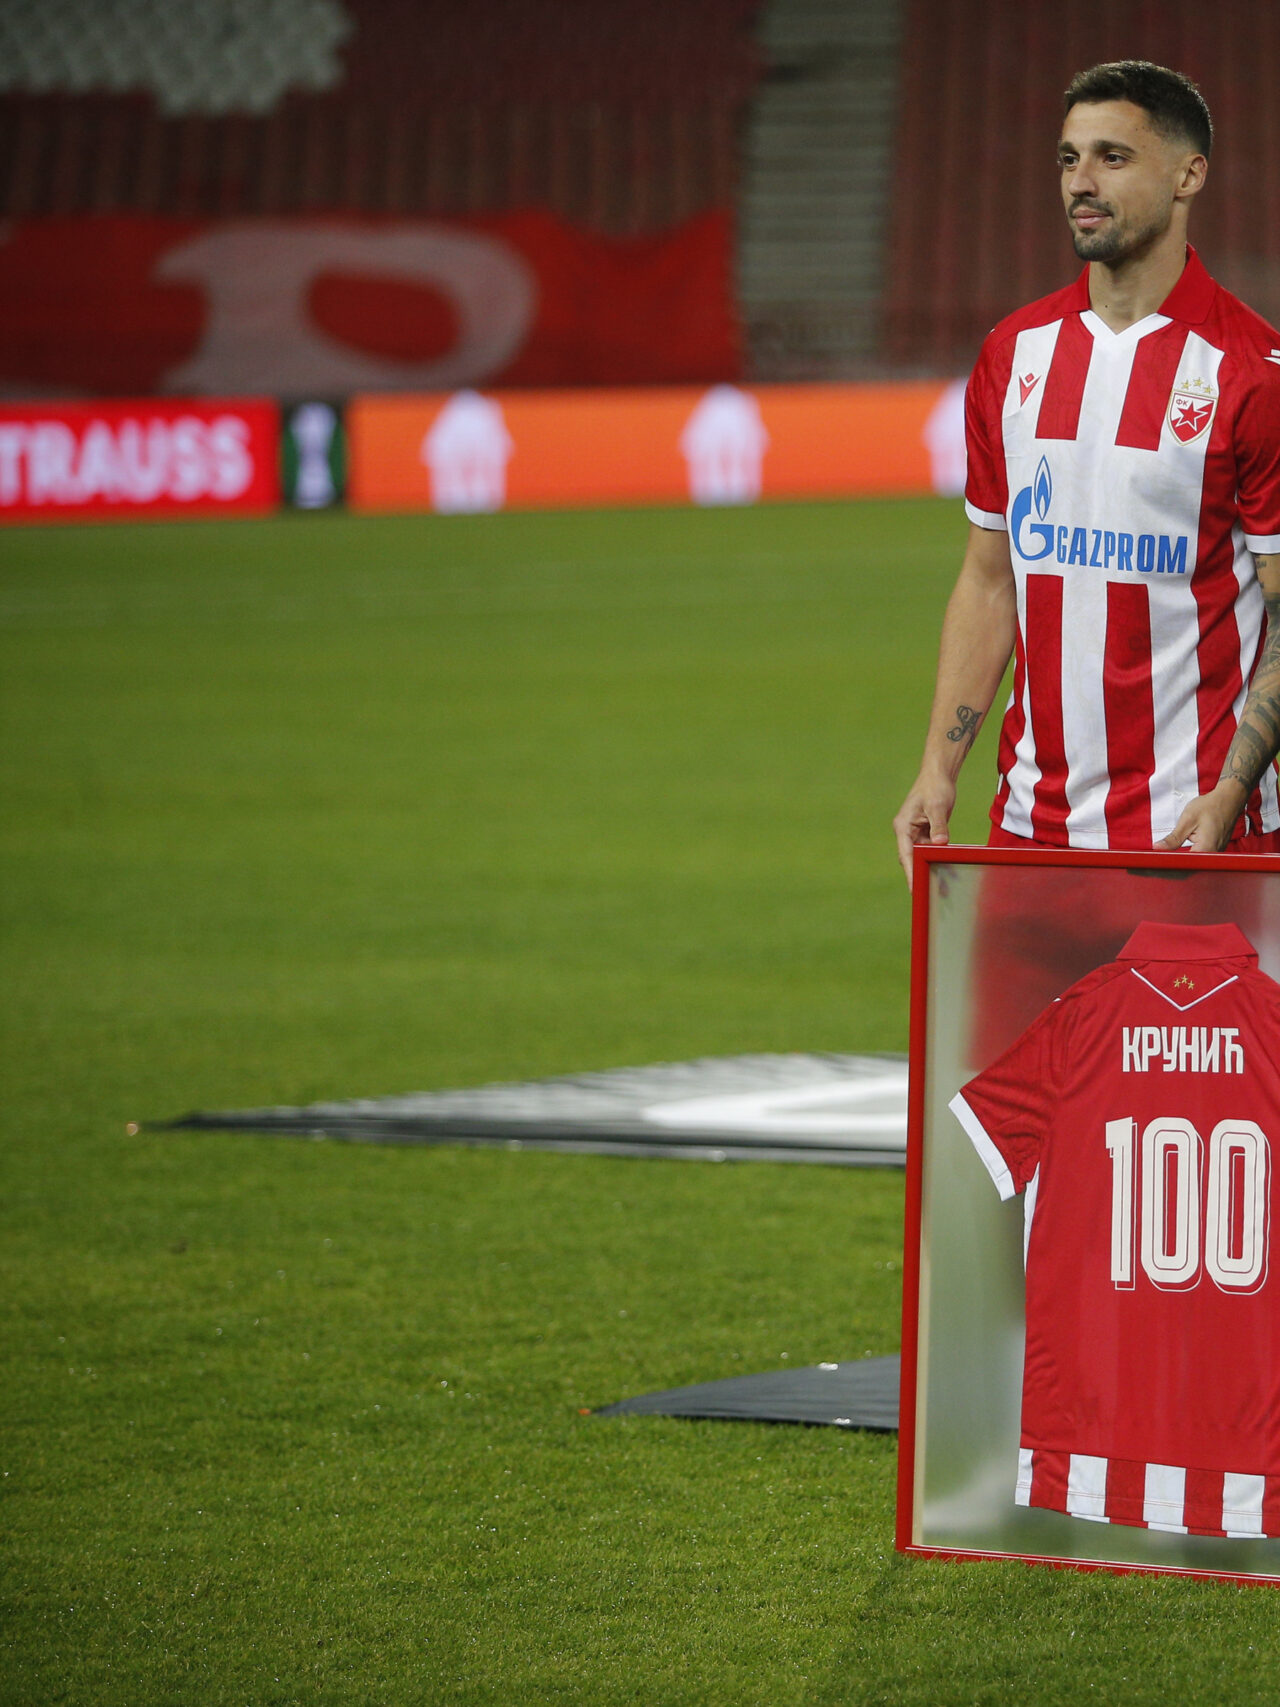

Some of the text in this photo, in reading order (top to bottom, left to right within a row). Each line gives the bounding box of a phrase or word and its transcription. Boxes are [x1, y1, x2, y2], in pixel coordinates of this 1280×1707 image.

[1175, 398, 1189, 407] ФК
[1056, 525, 1188, 574] GAZPROM
[1121, 1026, 1244, 1074] КРУНИЋ
[1105, 1116, 1272, 1295] 100
